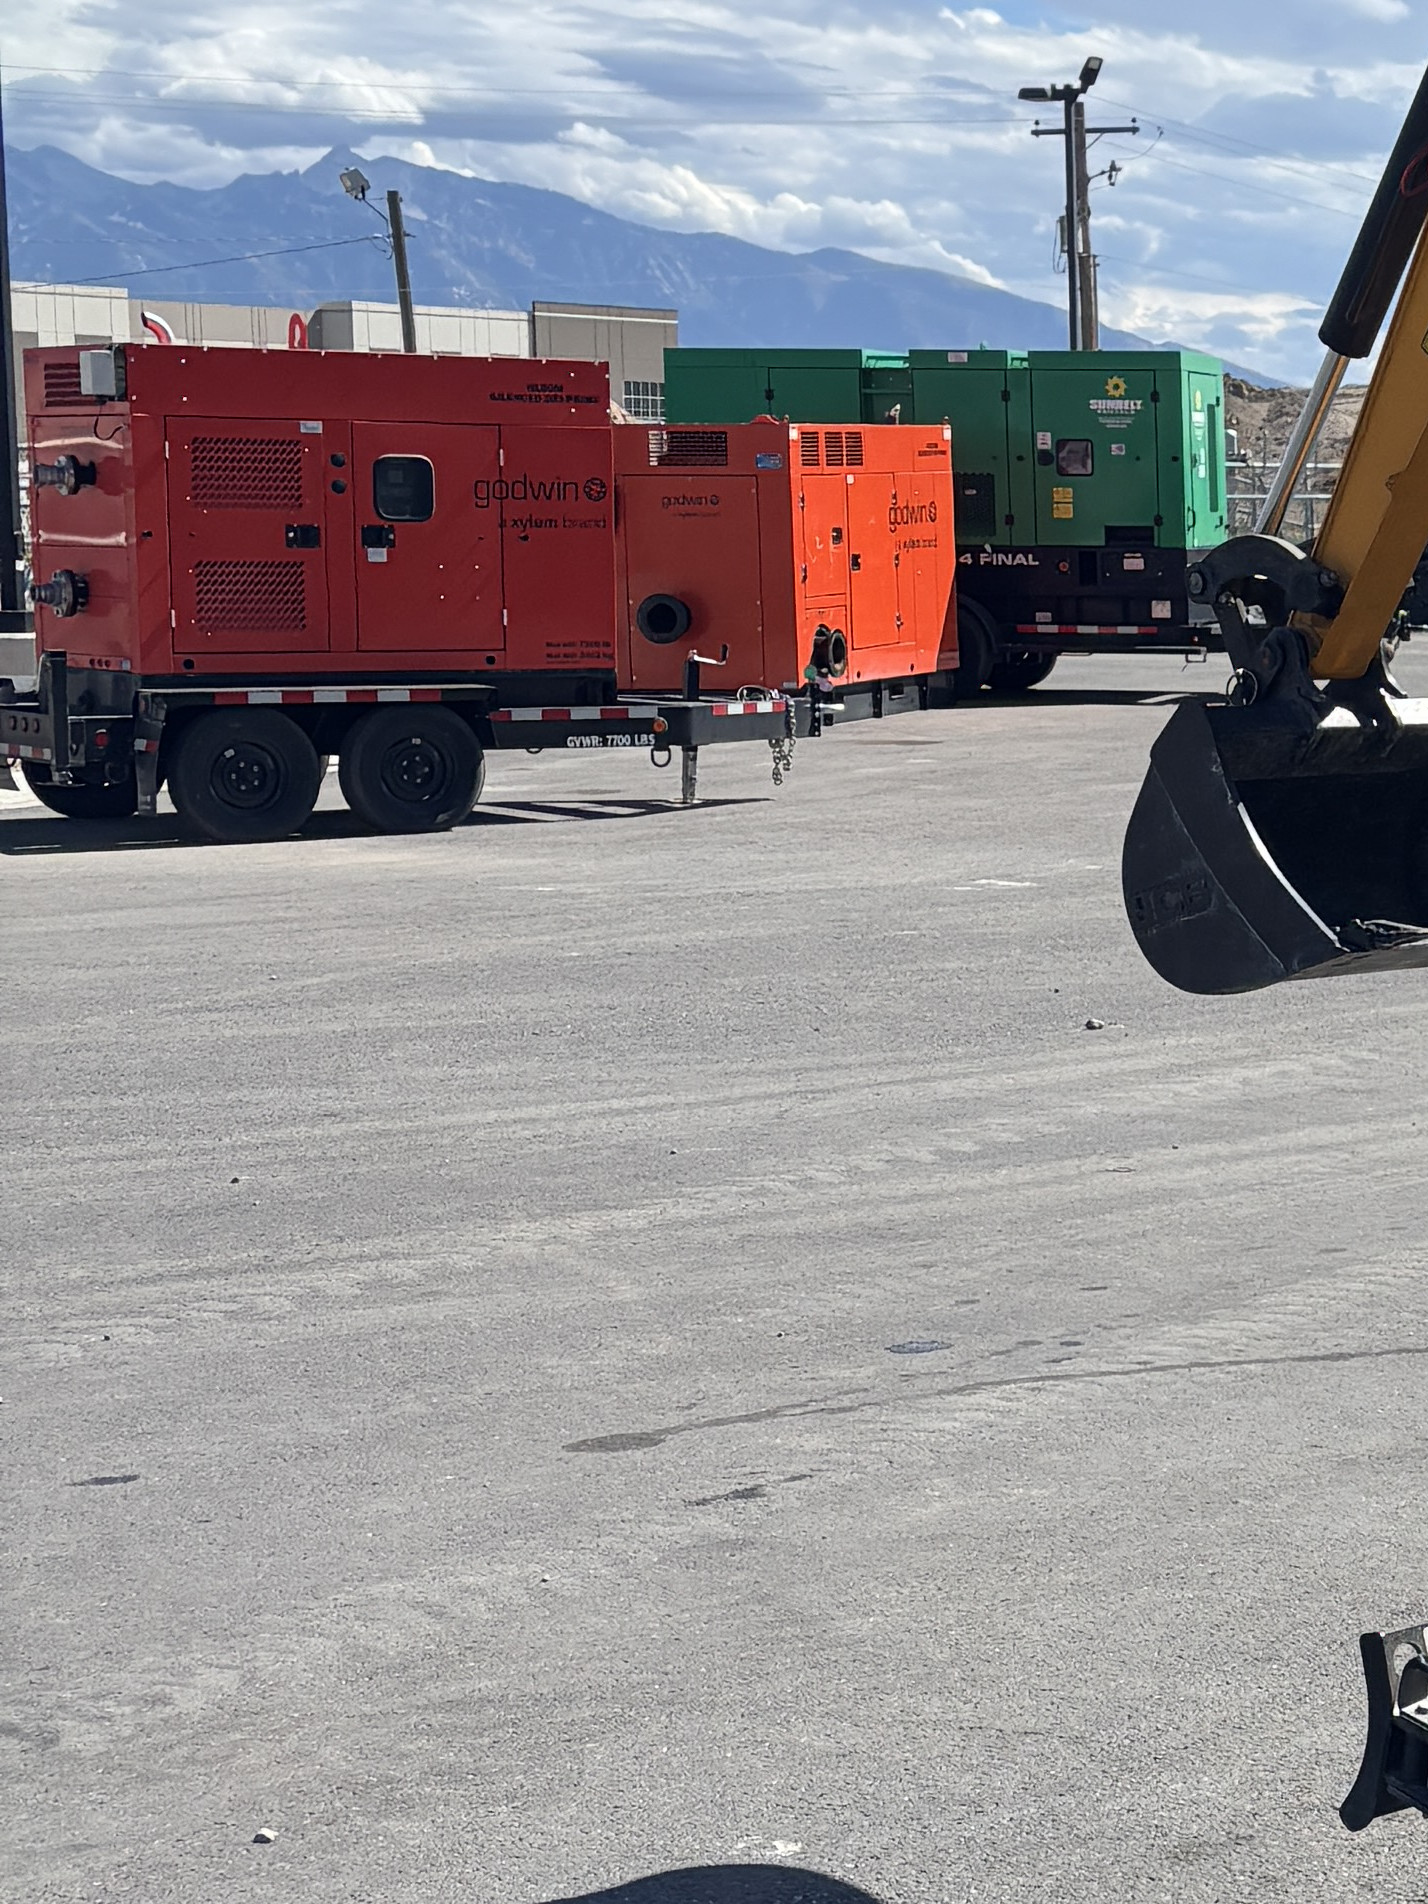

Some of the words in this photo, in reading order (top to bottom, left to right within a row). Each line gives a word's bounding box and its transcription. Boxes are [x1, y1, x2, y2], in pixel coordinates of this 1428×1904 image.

[474, 473, 579, 508] godwin
[510, 513, 558, 530] xylem
[888, 499, 928, 533] godwin
[980, 553, 1039, 565] FINAL
[566, 735, 603, 747] GVWR:
[606, 734, 631, 746] 7700
[634, 733, 656, 745] LBS
